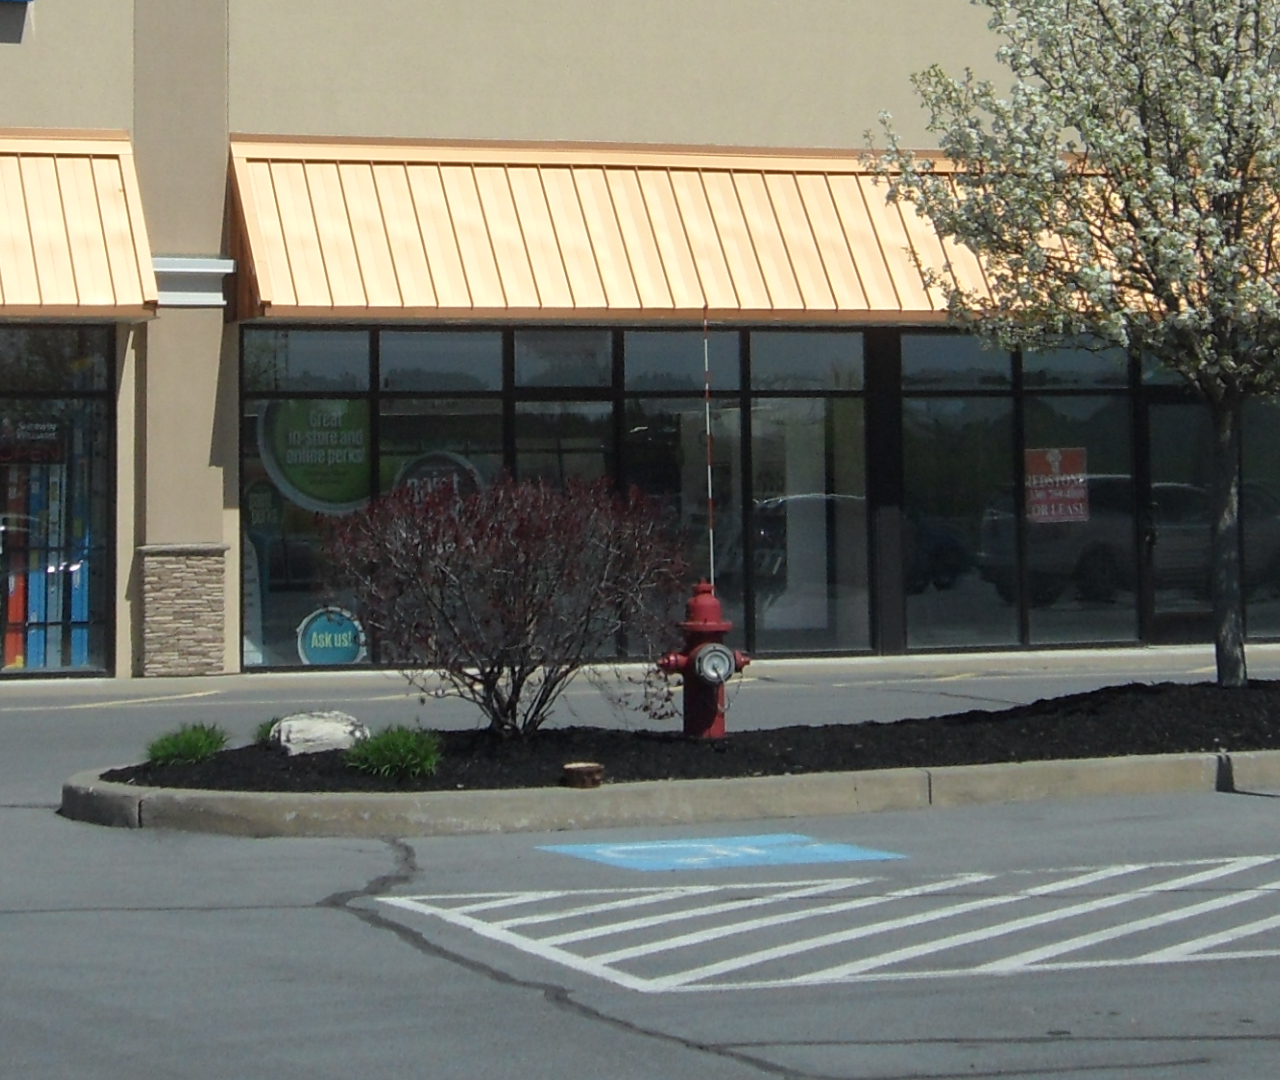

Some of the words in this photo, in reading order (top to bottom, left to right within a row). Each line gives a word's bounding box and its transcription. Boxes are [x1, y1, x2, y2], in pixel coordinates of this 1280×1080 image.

[340, 429, 364, 445] and
[286, 449, 325, 464] online
[311, 631, 333, 649] Ask
[334, 631, 353, 648] us!
